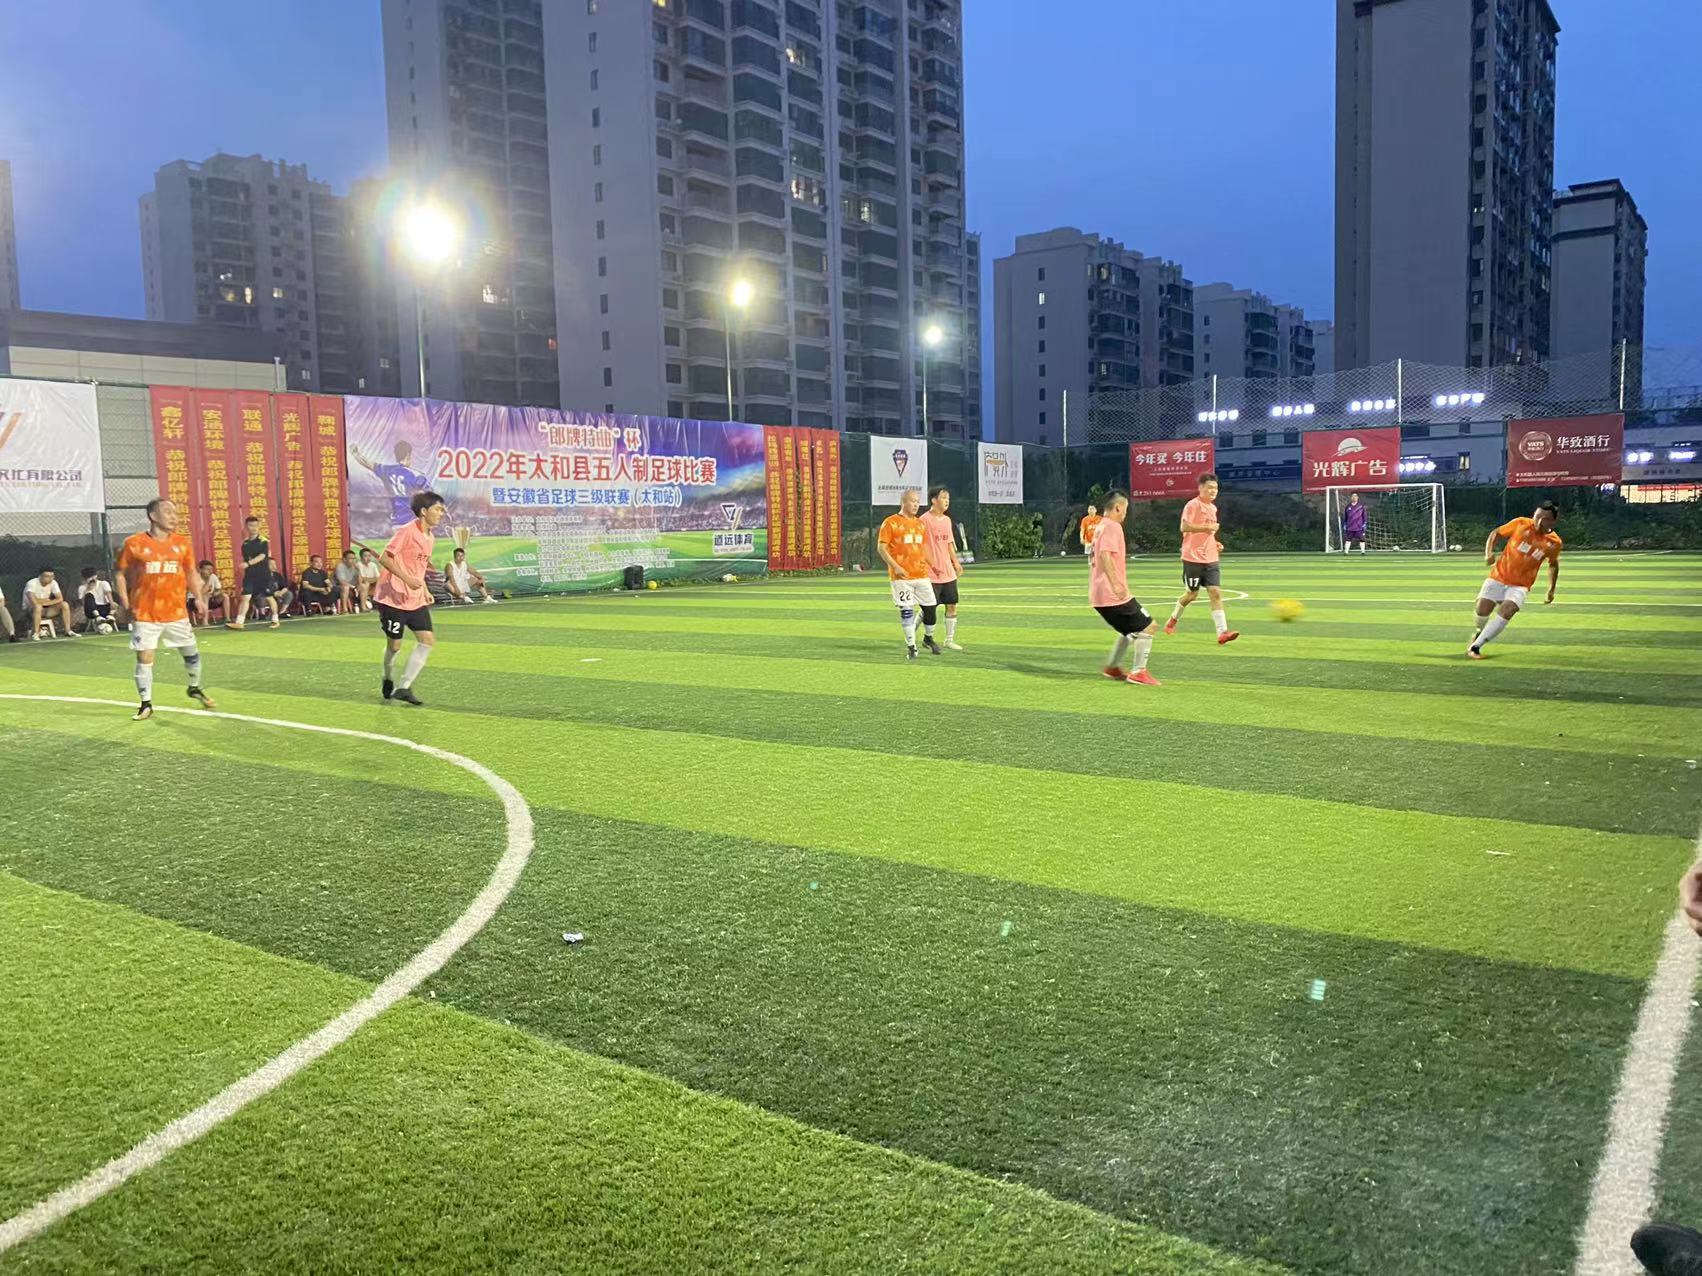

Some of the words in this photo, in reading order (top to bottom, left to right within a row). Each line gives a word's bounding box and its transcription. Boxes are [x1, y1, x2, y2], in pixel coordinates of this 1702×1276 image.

[1557, 434, 1610, 449] 华致酒行
[1135, 452, 1168, 465] 今年买
[1172, 450, 1208, 463] 今年住
[437, 449, 717, 484] 2022年太和县五人制足球比赛
[1313, 460, 1388, 477] 光辉广告
[1188, 577, 1200, 587] 17
[899, 590, 911, 601] 22
[387, 619, 401, 634] 12
